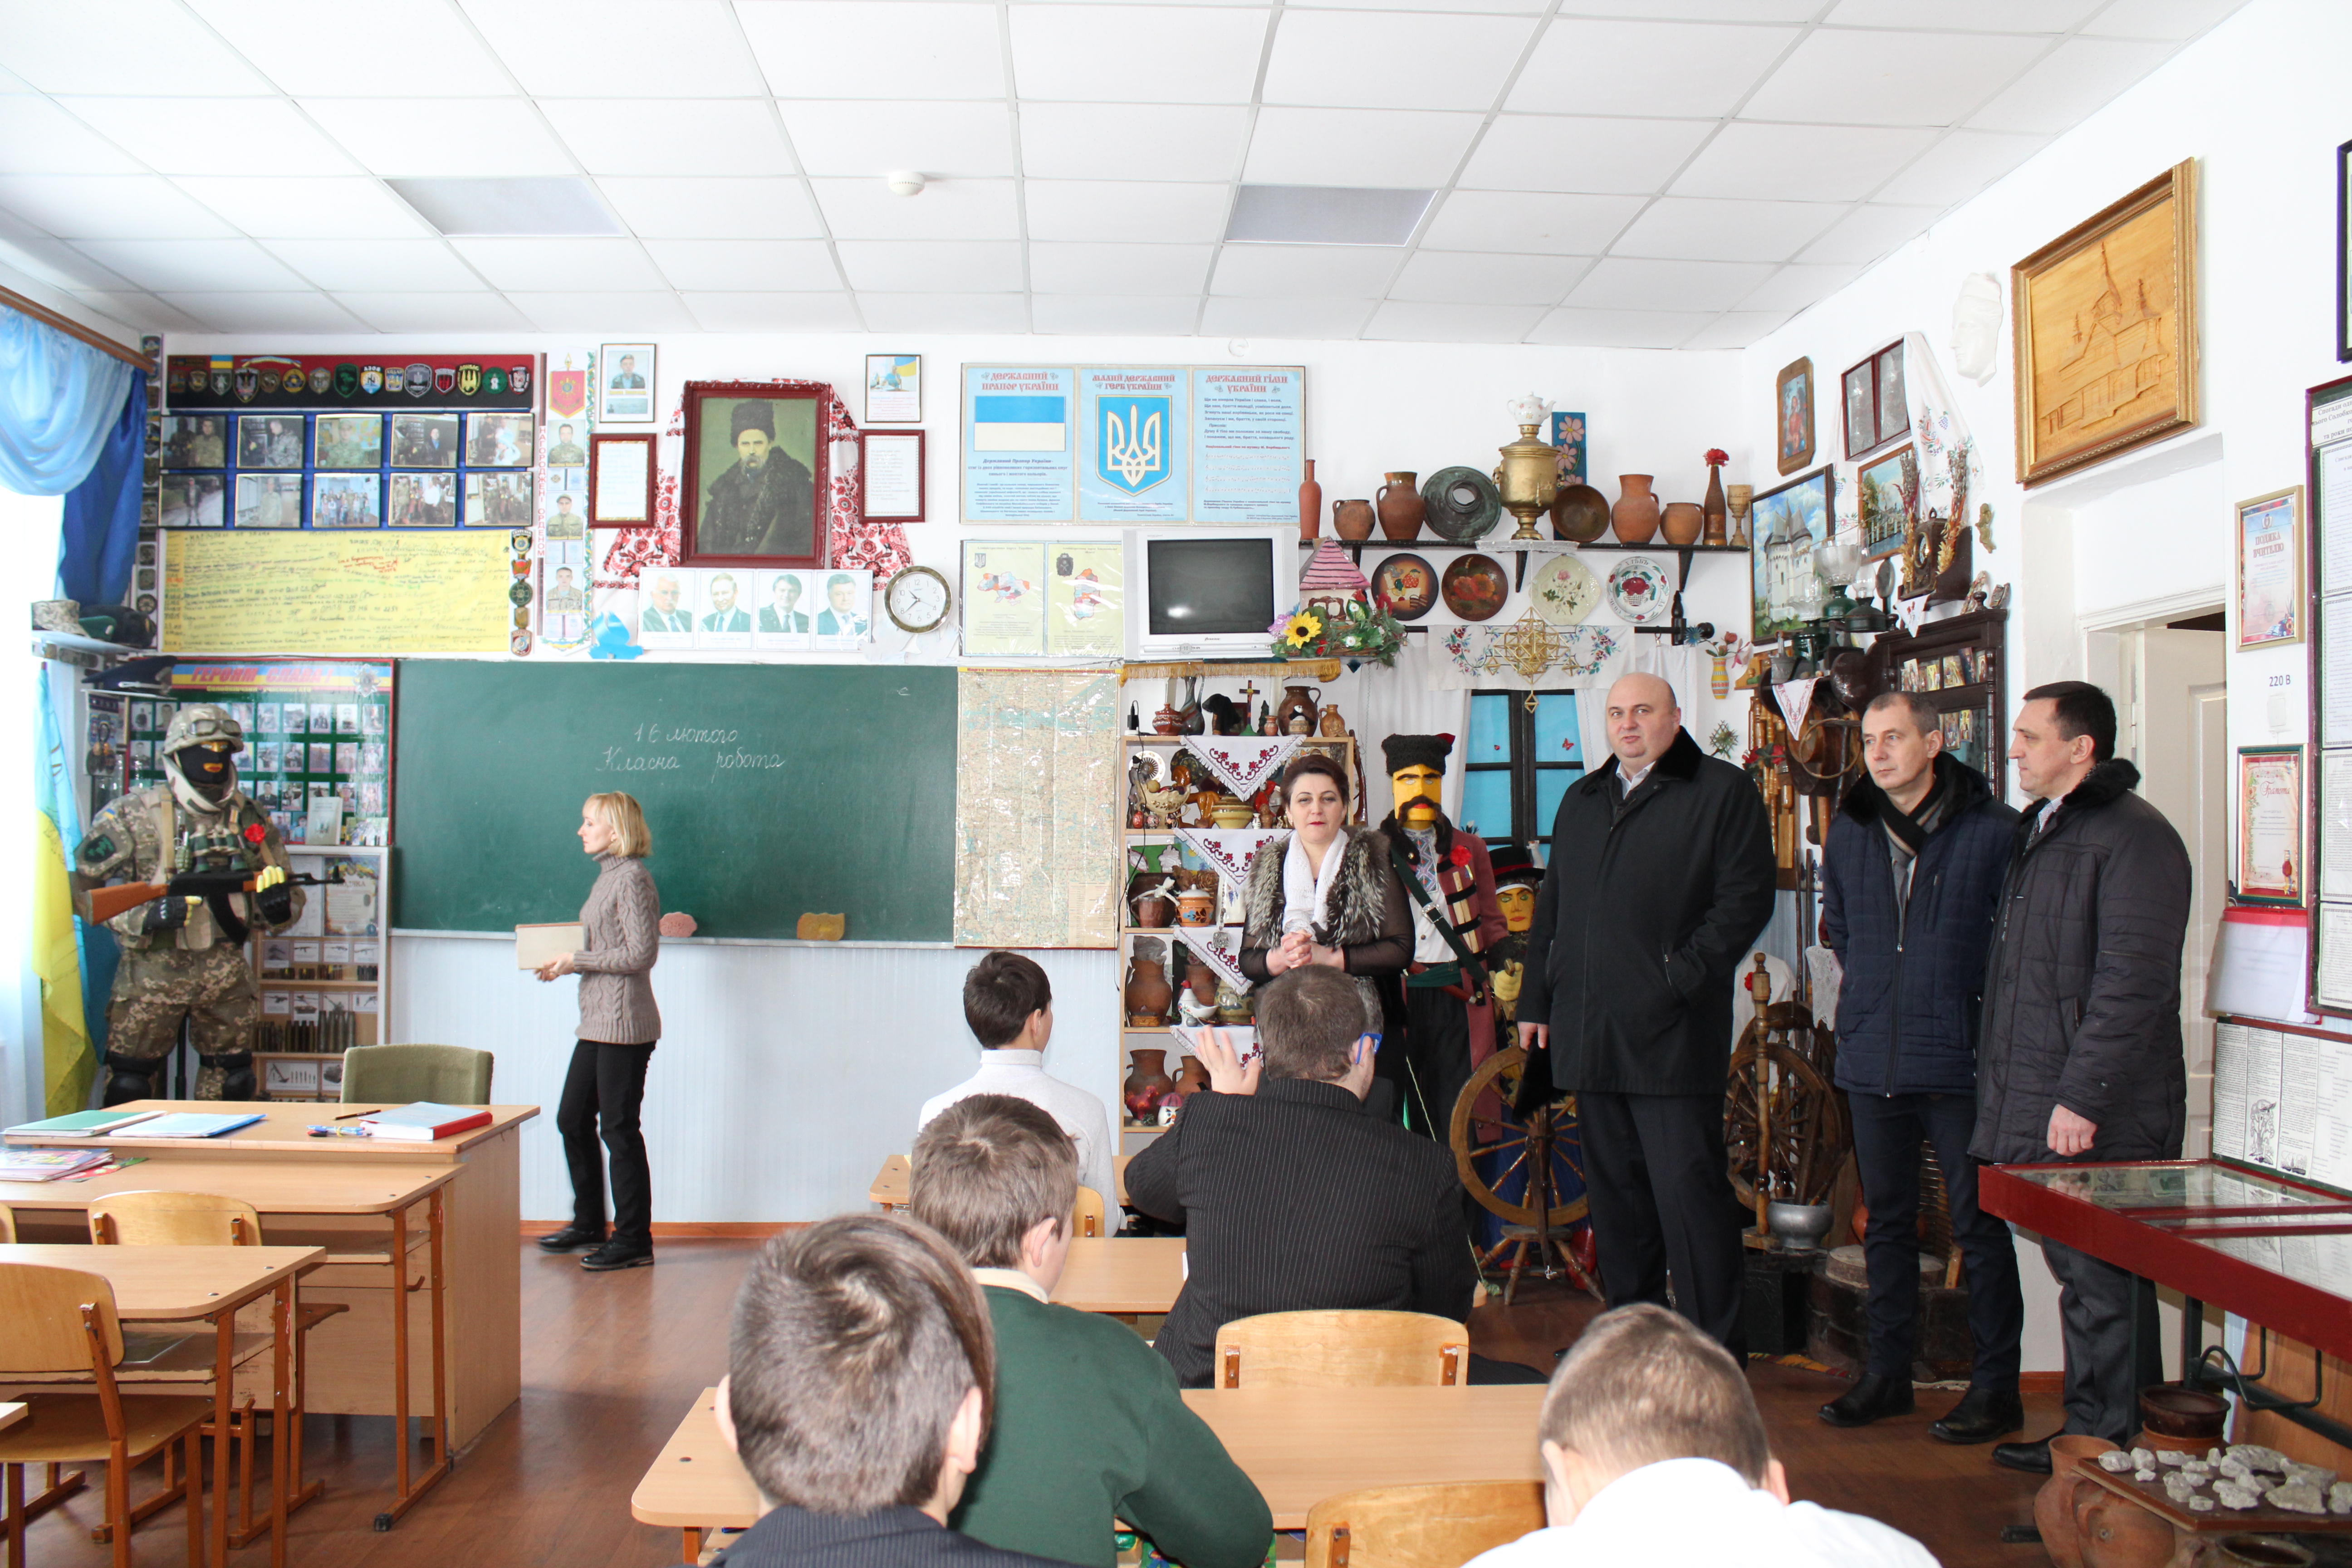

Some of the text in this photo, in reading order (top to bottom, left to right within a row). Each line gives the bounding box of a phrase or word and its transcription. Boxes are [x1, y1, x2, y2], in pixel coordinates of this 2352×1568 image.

[991, 372, 1048, 381] ДЕРЖАВНИЙ
[1124, 374, 1176, 382] ДЕРЖАВНИЙ
[1206, 374, 1288, 383] ДЕРЖАВНИЙ ГІМН
[1019, 381, 1059, 392] УКРАЇНИ
[1127, 382, 1162, 391] УКРАЇНИ
[1227, 384, 1267, 394] УКРАЇНИ
[2318, 403, 2342, 416] Спогади
[2331, 429, 2345, 439] роки
[537, 426, 546, 556] НАГОРОДЖЕНІ ОРДЕНОМ
[2255, 531, 2281, 545] ПОДЯКА
[2253, 542, 2284, 558] ВЧИТЕЛЮ
[191, 667, 259, 682] ГЕРОЯМ
[2269, 675, 2284, 687] 220
[634, 722, 738, 743] 16 лютого
[595, 745, 786, 784] Класна робота
[2259, 780, 2291, 799] Грамота
